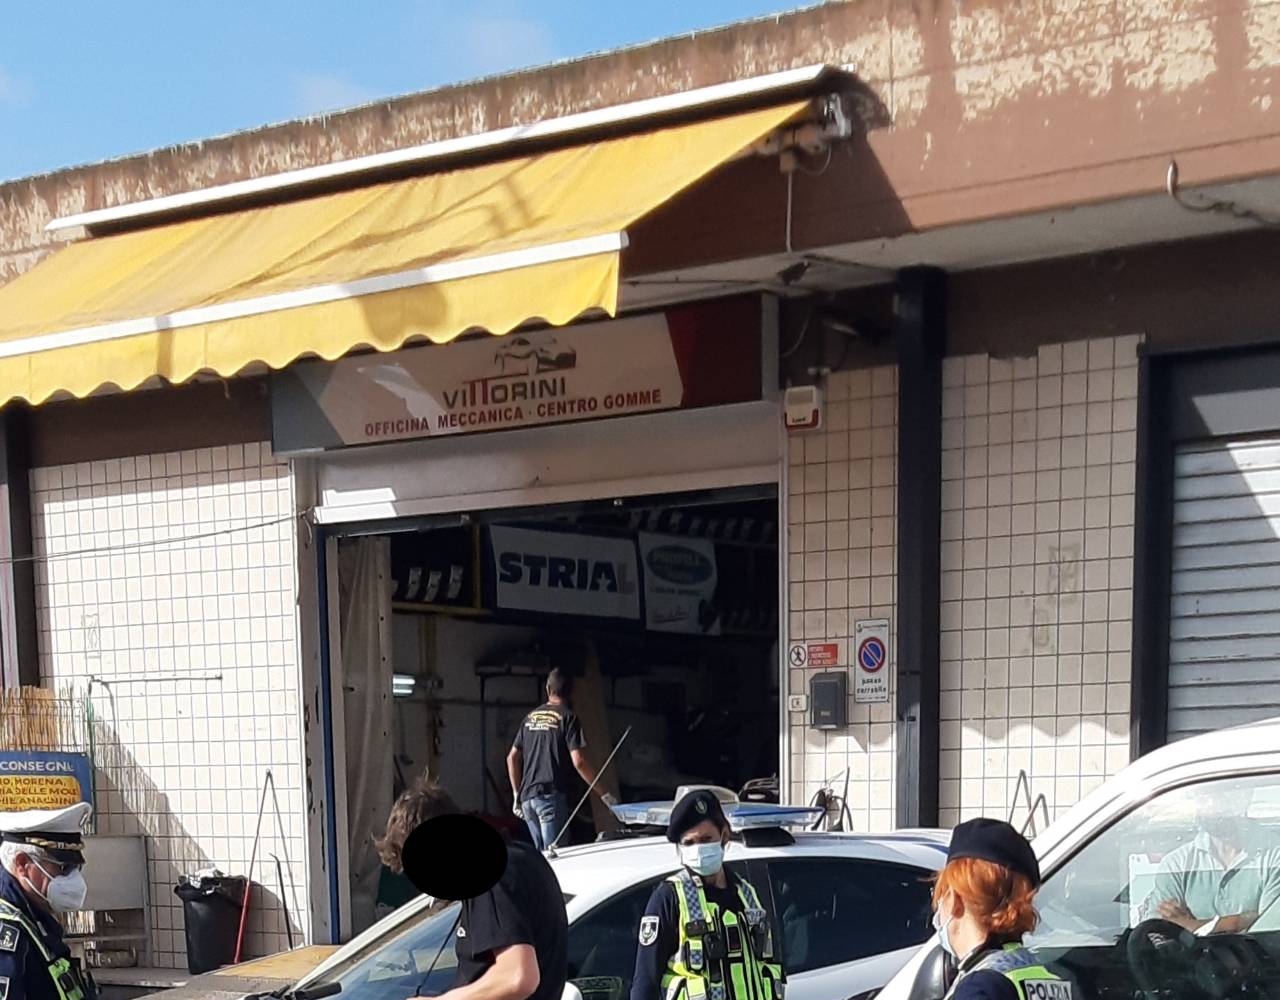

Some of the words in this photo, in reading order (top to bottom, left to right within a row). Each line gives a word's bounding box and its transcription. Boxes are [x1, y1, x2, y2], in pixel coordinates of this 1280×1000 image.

[442, 374, 567, 409] VITTORINI
[364, 417, 429, 436] OFFICINA
[437, 408, 524, 429] MECCANICA
[536, 397, 598, 417] CENTRO
[604, 389, 662, 410] GOMME
[1026, 983, 1070, 1000] POLIZIA
